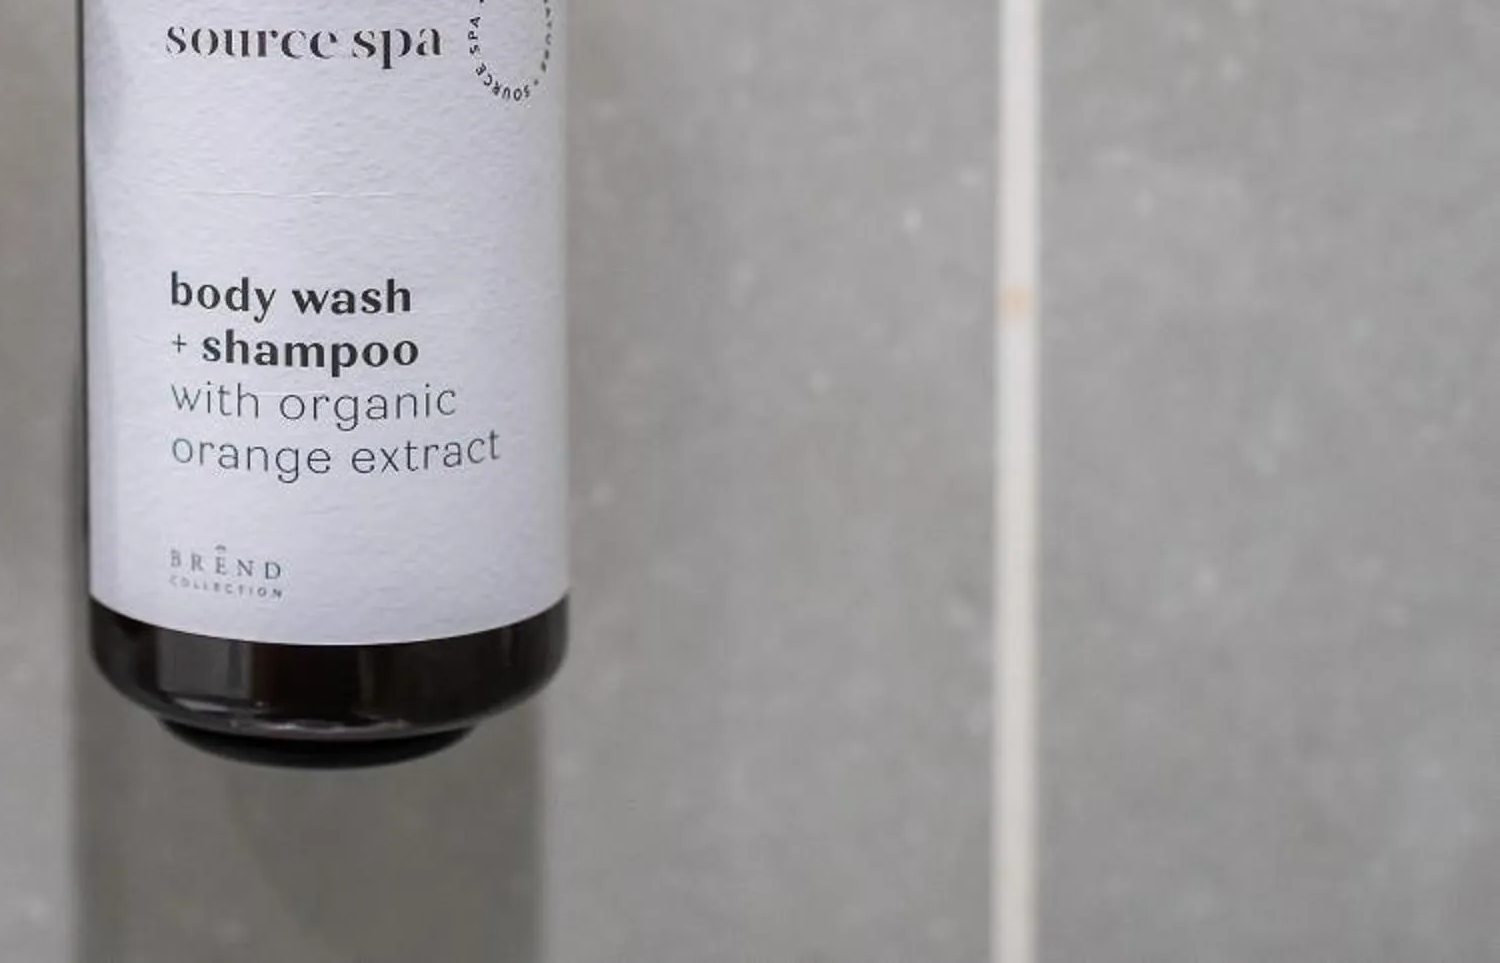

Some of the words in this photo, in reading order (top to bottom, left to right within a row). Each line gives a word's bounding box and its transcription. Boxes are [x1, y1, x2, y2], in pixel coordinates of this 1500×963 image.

[165, 25, 338, 60] source
[352, 27, 443, 69] spa
[467, 16, 481, 55] SPA
[475, 63, 531, 101] SOURCE
[171, 271, 277, 323] body
[292, 278, 412, 314] wash
[172, 333, 188, 354] +
[201, 328, 420, 377] shampoo
[170, 381, 260, 418] with
[279, 383, 458, 431] organic
[172, 437, 332, 484] orange
[351, 429, 500, 474] extract
[169, 575, 282, 598] COLLECTION
